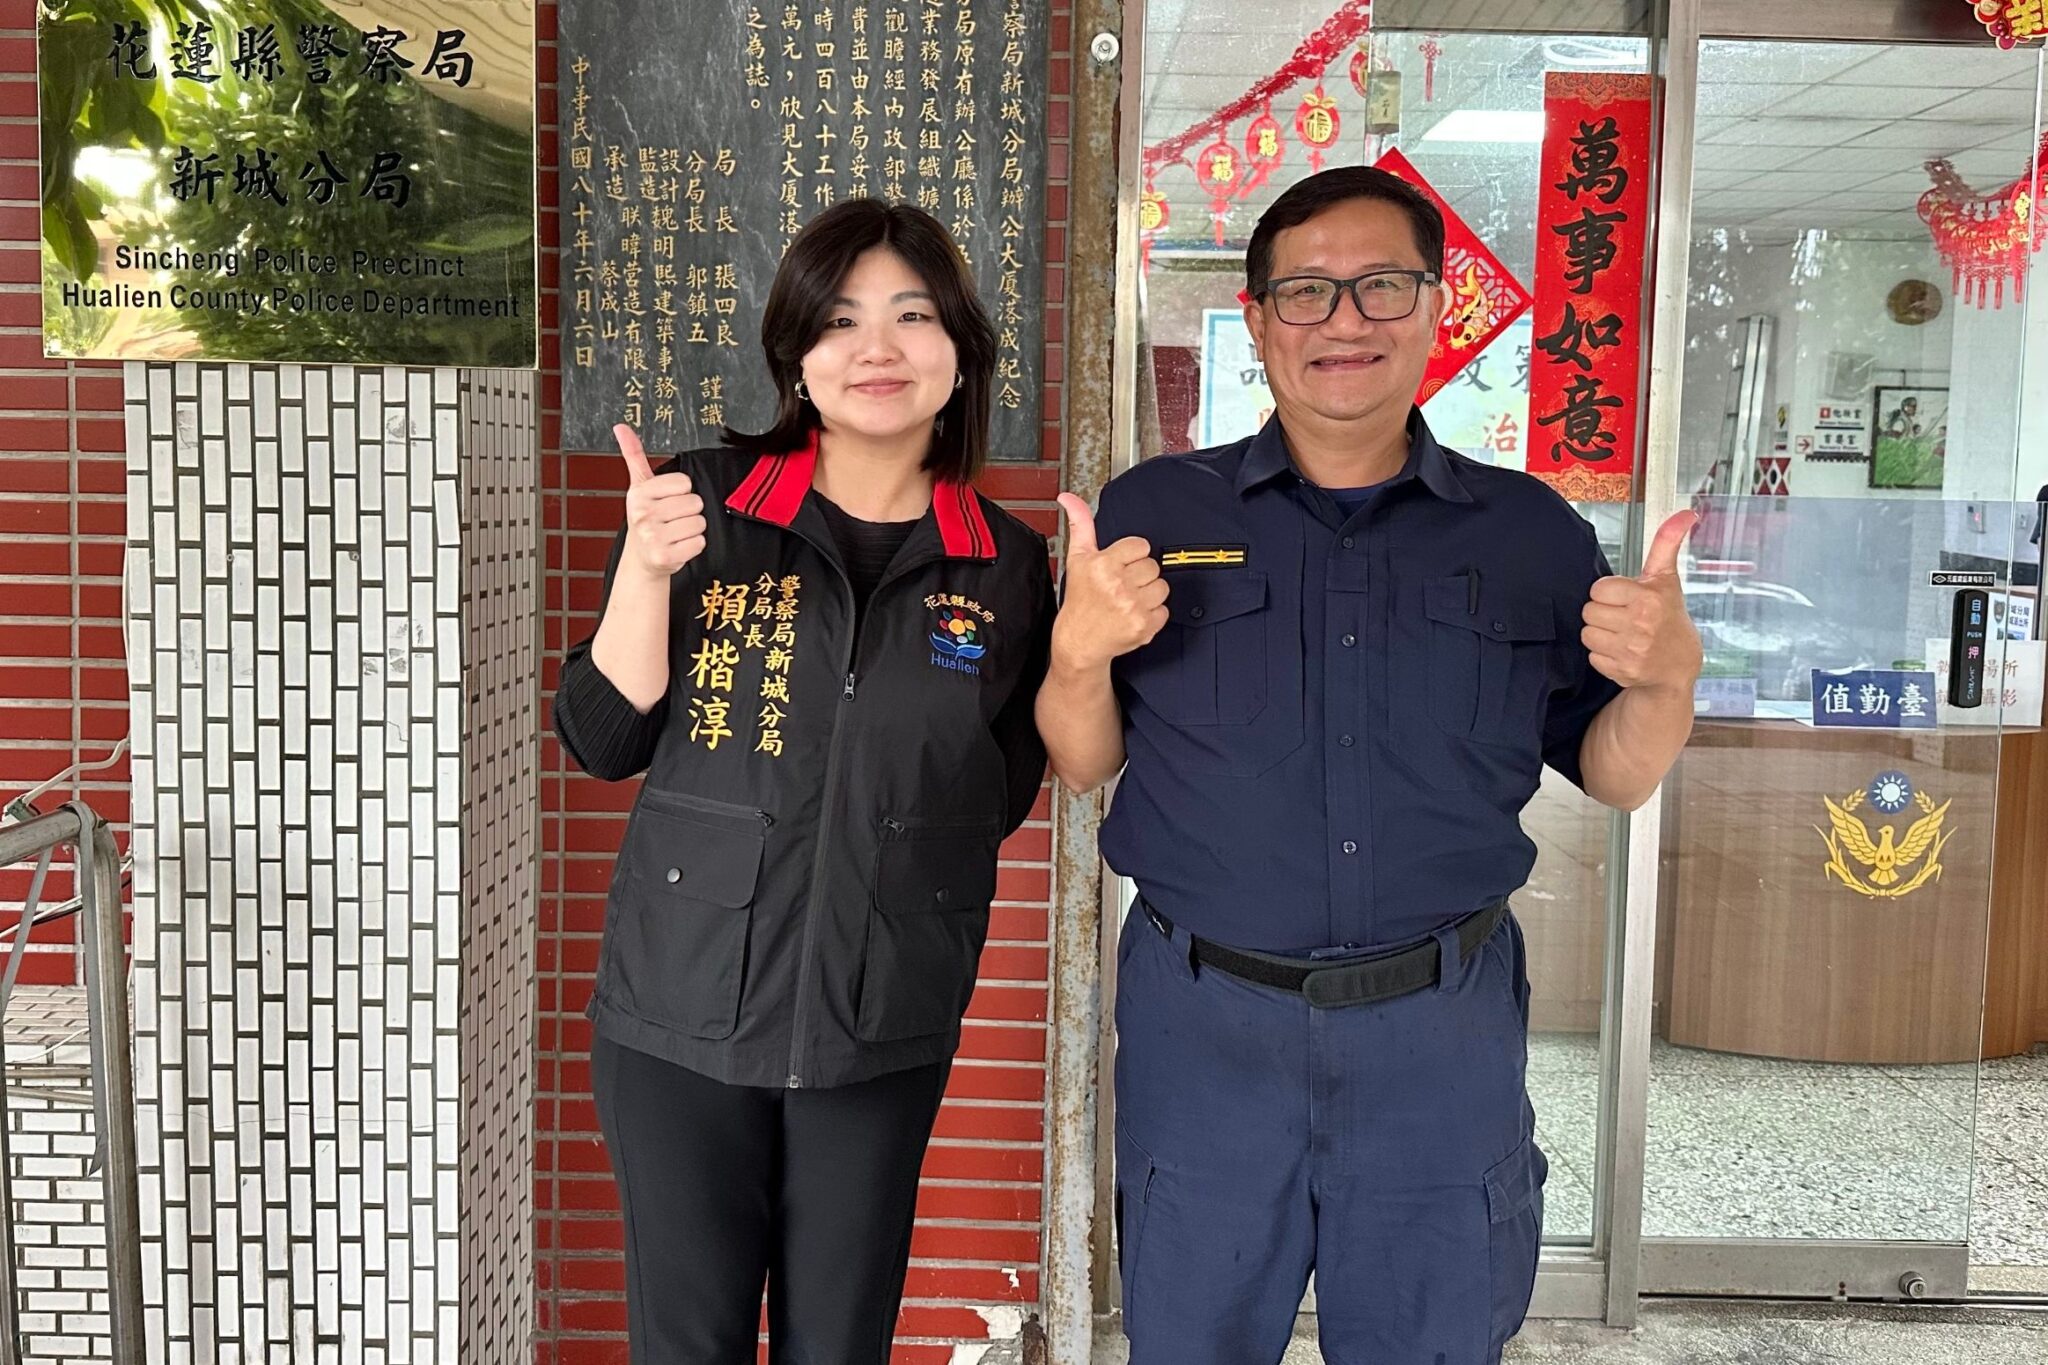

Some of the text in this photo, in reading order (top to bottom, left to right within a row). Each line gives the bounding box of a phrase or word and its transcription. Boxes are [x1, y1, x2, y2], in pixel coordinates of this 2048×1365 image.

[106, 21, 475, 89] 花蓮縣警察局
[779, 5, 804, 259] 萬元，欣見大廈落
[814, 7, 837, 207] 時四百八十工作
[918, 0, 943, 210] 業務發展組織擴
[951, 0, 977, 265] 局原有辦公廳係於
[115, 245, 465, 278] Sincheng Police Precinct
[168, 146, 413, 208] 新城分局
[571, 56, 595, 368] 中華民國八十年六月六日
[998, 0, 1027, 409] 察局新城分局辦公大廈落成紀念
[62, 282, 520, 320] Hualien County Police Department
[1535, 115, 1629, 462] 萬事如意
[687, 579, 750, 751] 賴楷淳
[743, 571, 778, 649] 分局長
[754, 574, 801, 757] 警察局新城分局
[924, 592, 996, 624] 花蓮縣政府
[931, 652, 980, 676] Hualien
[1820, 682, 1928, 717] 值勤臺
